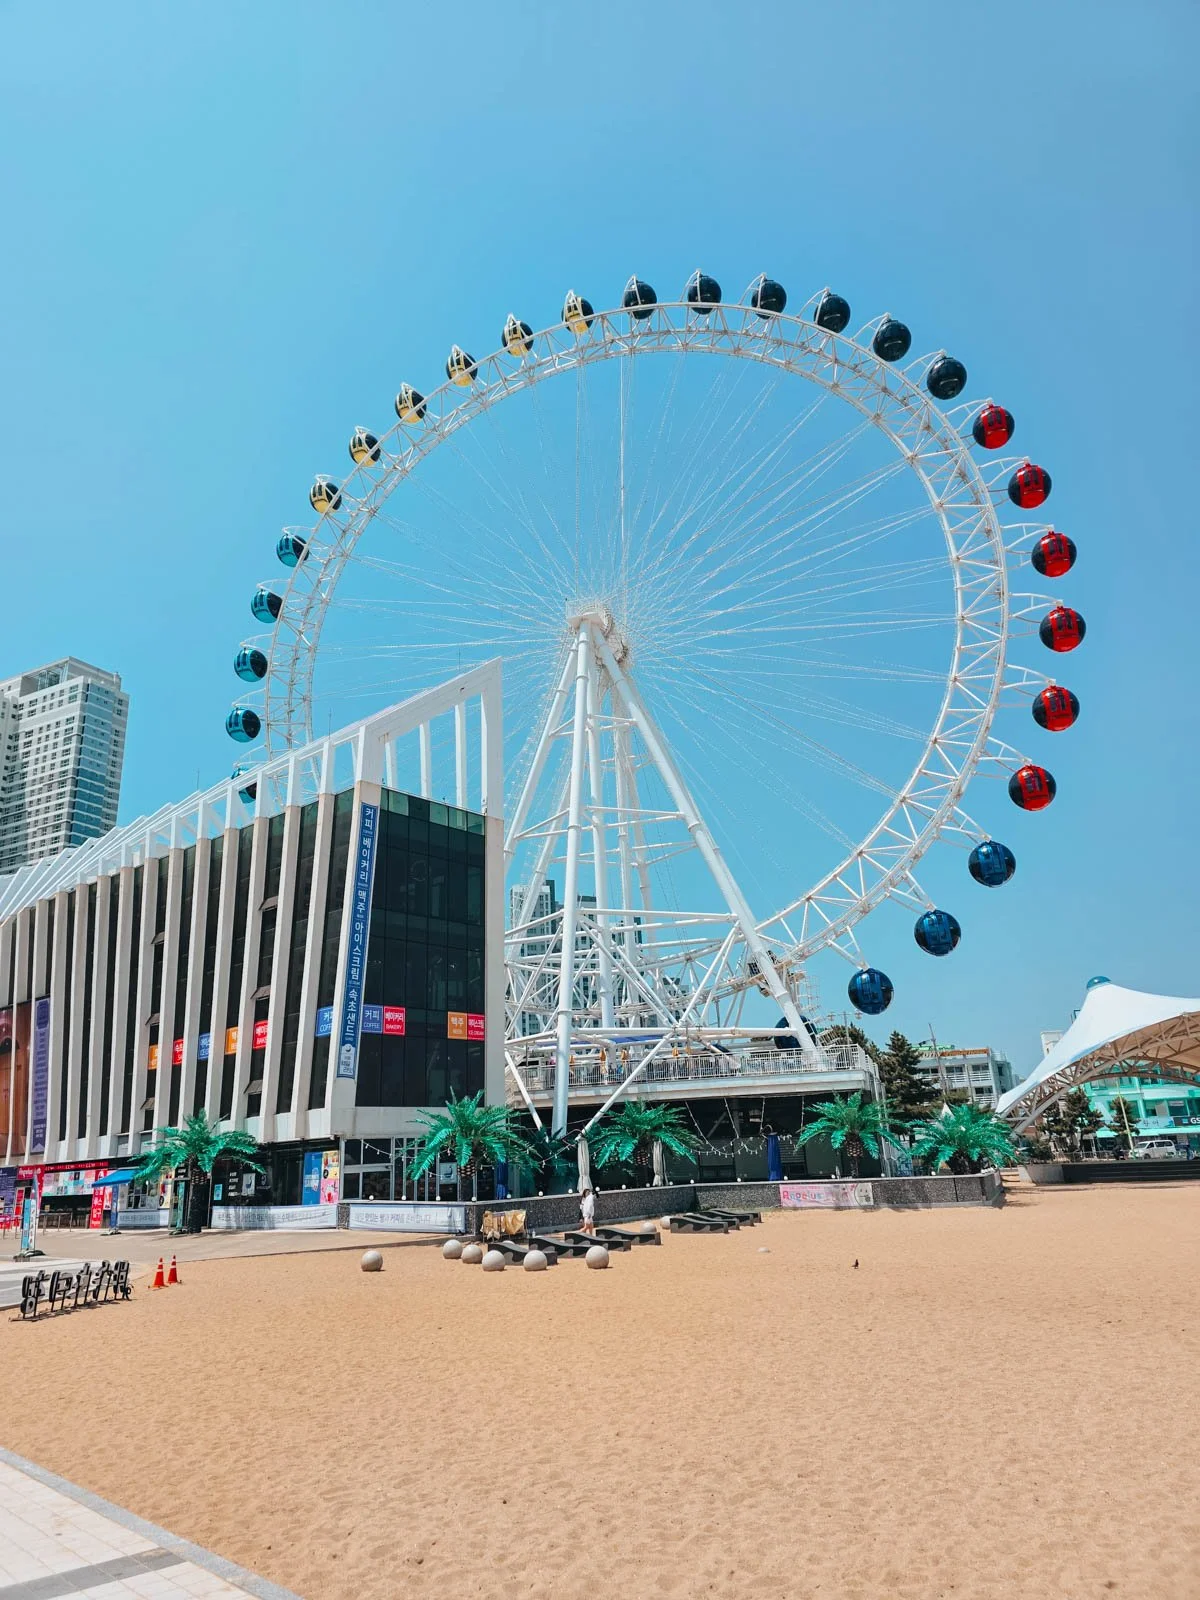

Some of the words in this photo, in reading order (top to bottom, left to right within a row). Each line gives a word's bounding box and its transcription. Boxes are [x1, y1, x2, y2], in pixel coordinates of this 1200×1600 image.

[365, 807, 375, 830] 커피
[359, 837, 372, 883] 베이커리
[356, 890, 367, 914] 맥주
[351, 922, 364, 980] 아이스크림
[344, 988, 359, 1037] 속초샌드
[364, 1009, 380, 1021] 커피
